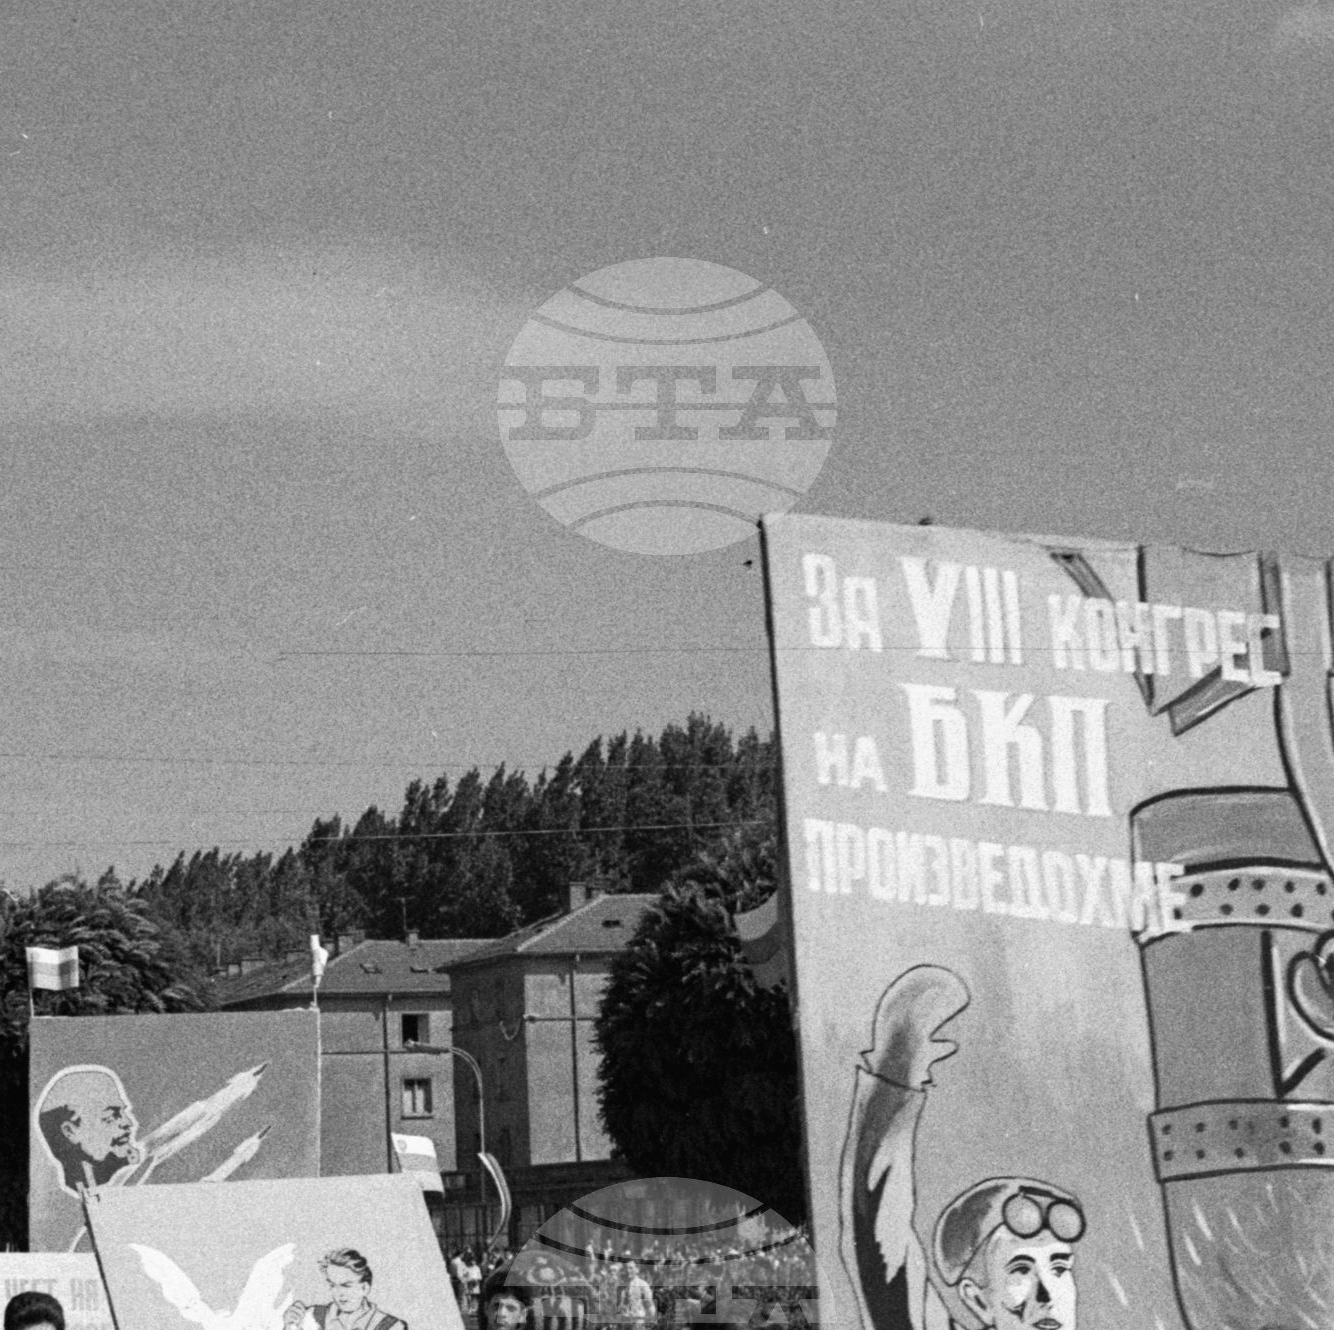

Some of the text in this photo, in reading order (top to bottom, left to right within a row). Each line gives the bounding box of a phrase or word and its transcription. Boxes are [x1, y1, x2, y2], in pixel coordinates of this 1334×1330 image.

[1047, 592, 1283, 687] КОНГРЕС
[813, 680, 1114, 818] НА БКП
[802, 818, 1195, 940] ПРОИЗВЕДОХМЕ
[70, 1278, 99, 1311] НА
